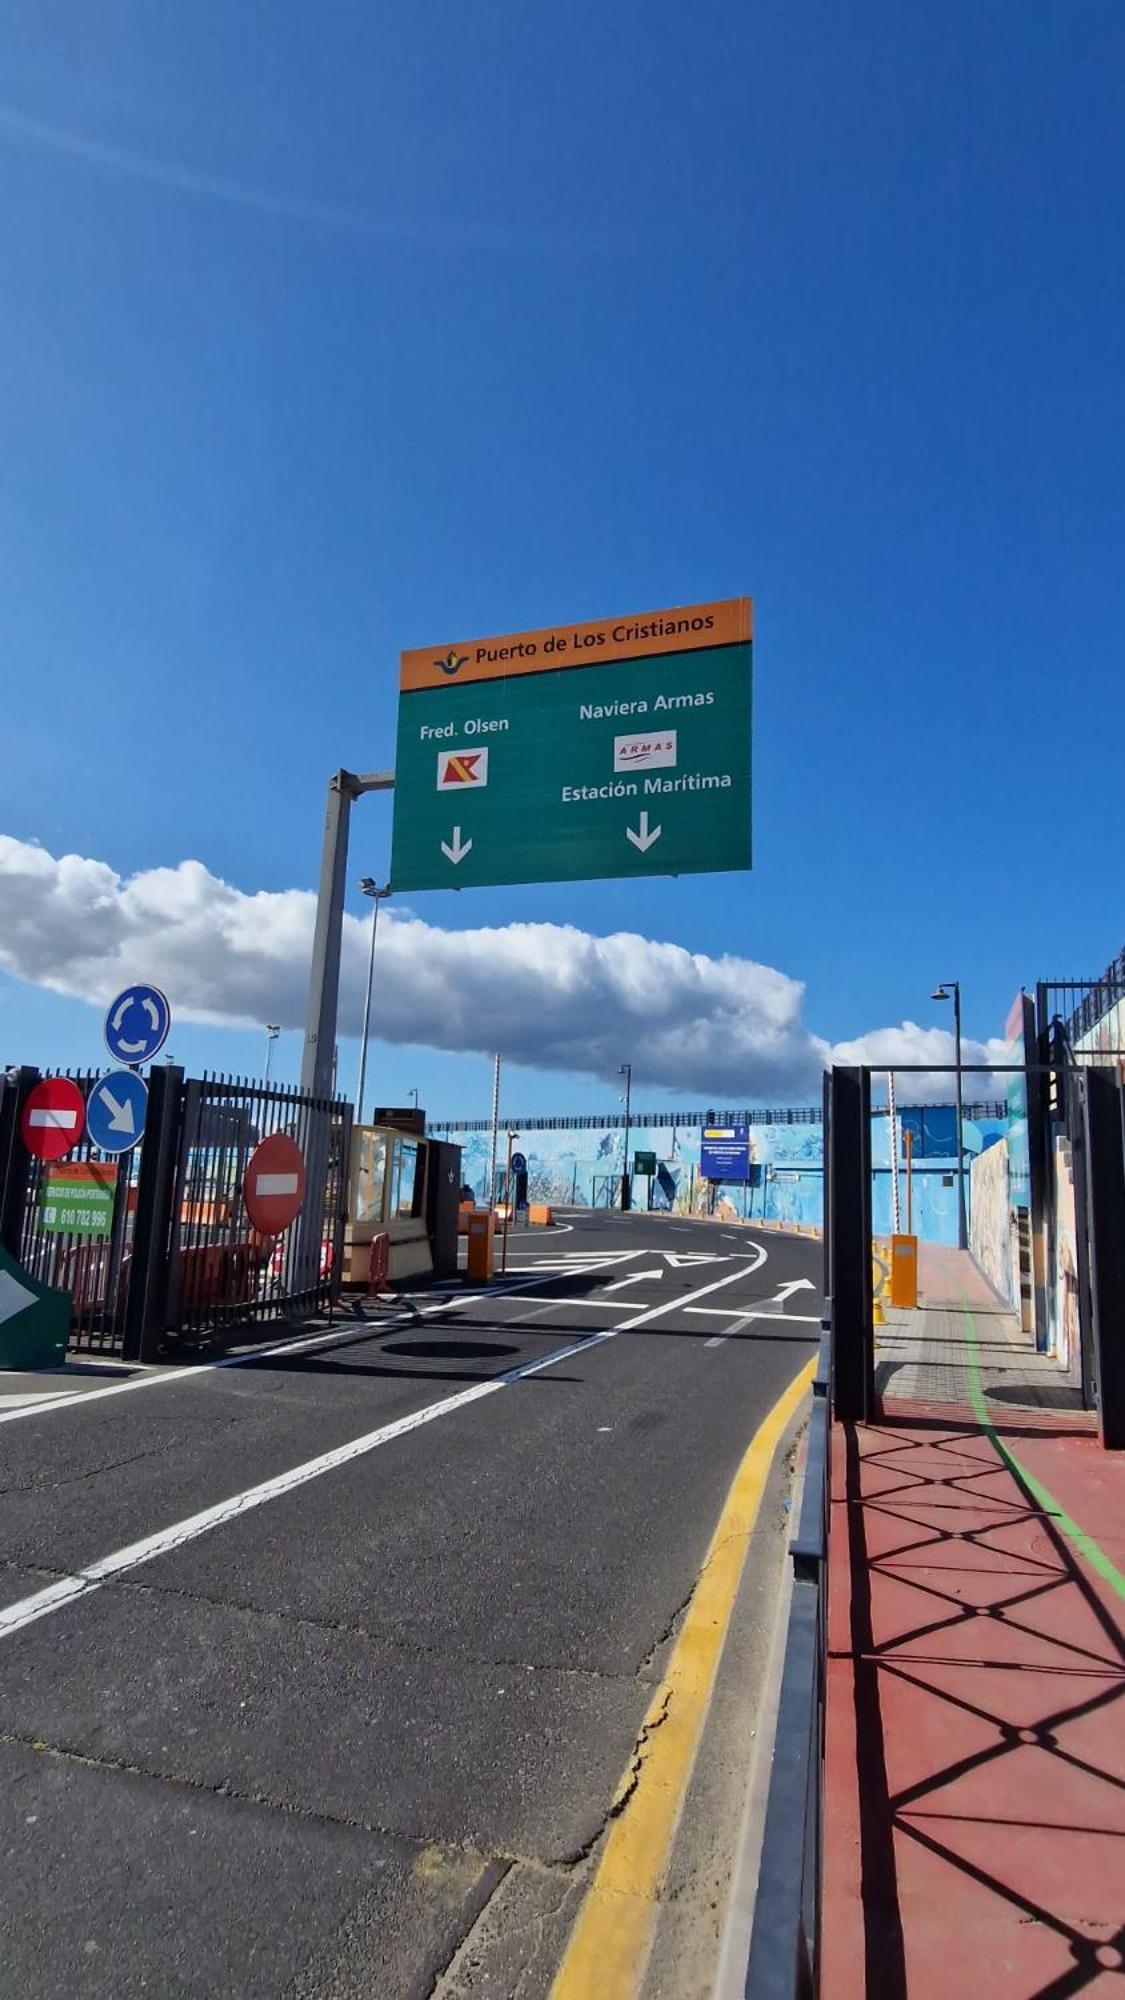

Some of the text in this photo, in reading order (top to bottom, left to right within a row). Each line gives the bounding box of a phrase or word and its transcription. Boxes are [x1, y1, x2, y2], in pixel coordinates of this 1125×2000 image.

[476, 615, 715, 664] Puerto de Los Cristianos
[580, 690, 715, 721] Naviera Armas
[420, 718, 510, 741] Fred. Olsen
[618, 741, 673, 756] ARMAS
[561, 774, 732, 803] Estación Marítima
